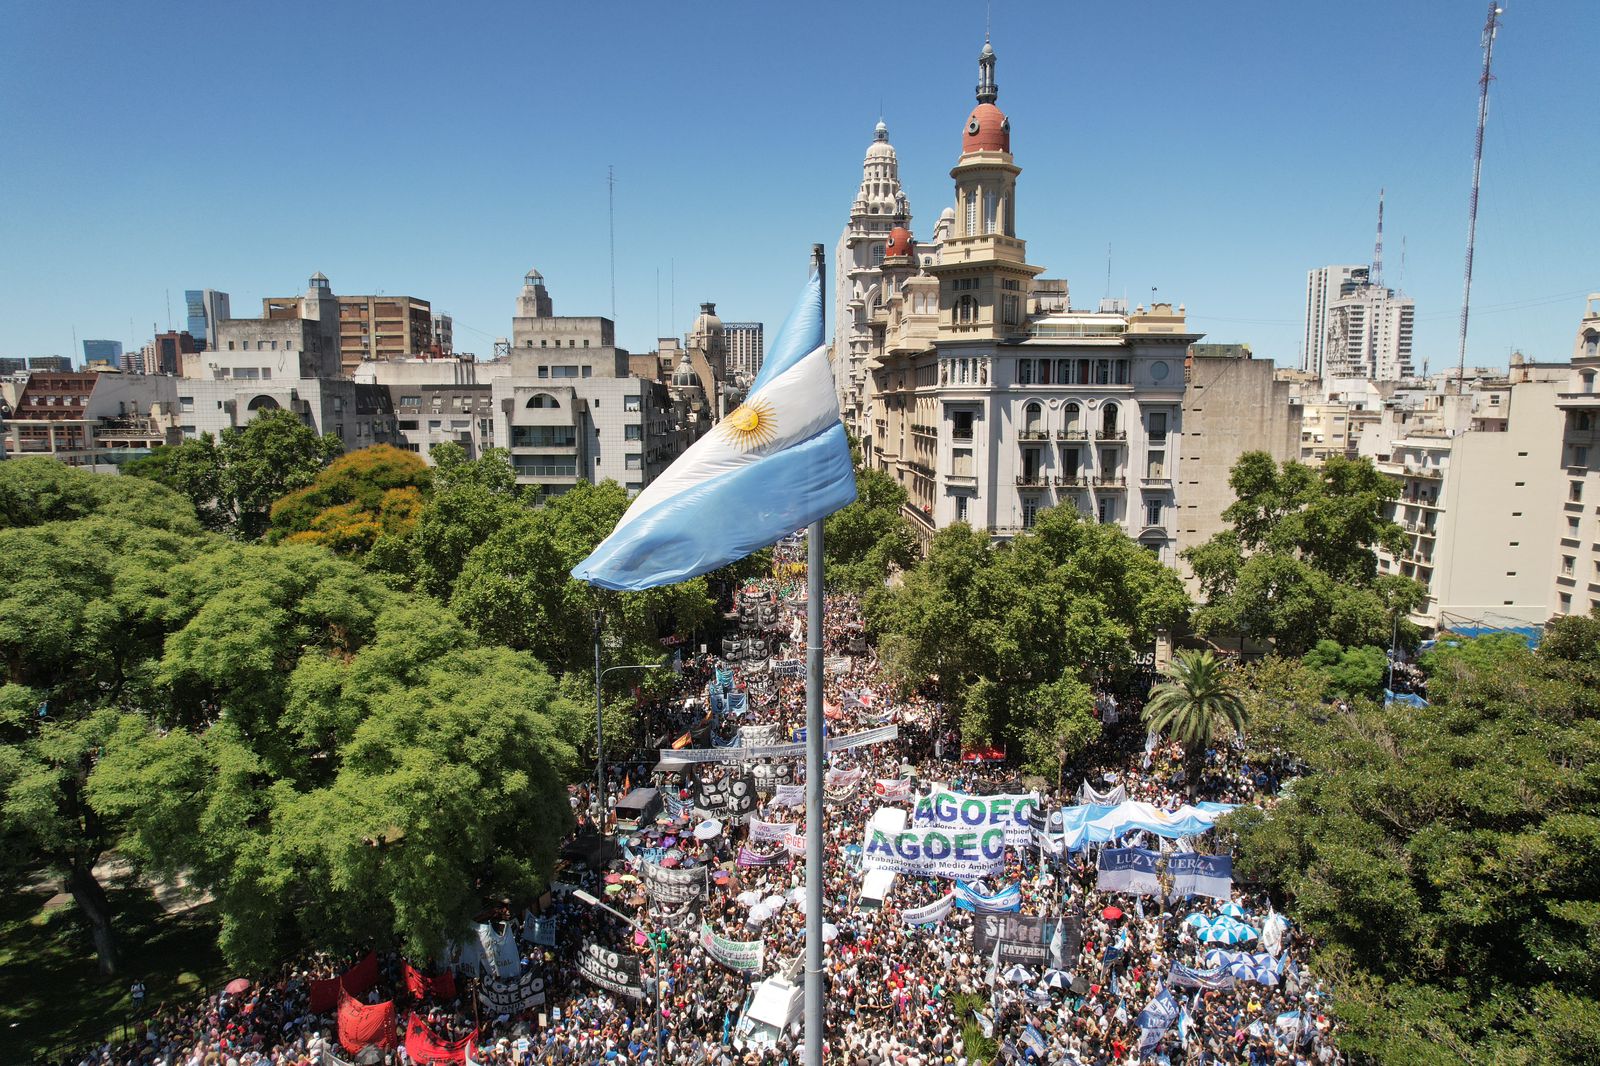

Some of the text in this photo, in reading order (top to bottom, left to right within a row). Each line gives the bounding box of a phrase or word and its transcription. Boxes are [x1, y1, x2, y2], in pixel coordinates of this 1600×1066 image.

[914, 792, 1037, 826] AGOEC
[866, 827, 1004, 861] AGOEC
[867, 855, 921, 868] Trabajadores
[968, 860, 1003, 870] Ambiente
[1116, 853, 1142, 865] LUZ
[1146, 857, 1156, 866] Y
[1168, 858, 1215, 871] UERZA
[648, 866, 691, 883] POLO
[646, 877, 701, 897] OBRERO
[577, 950, 629, 984] OBRERO
